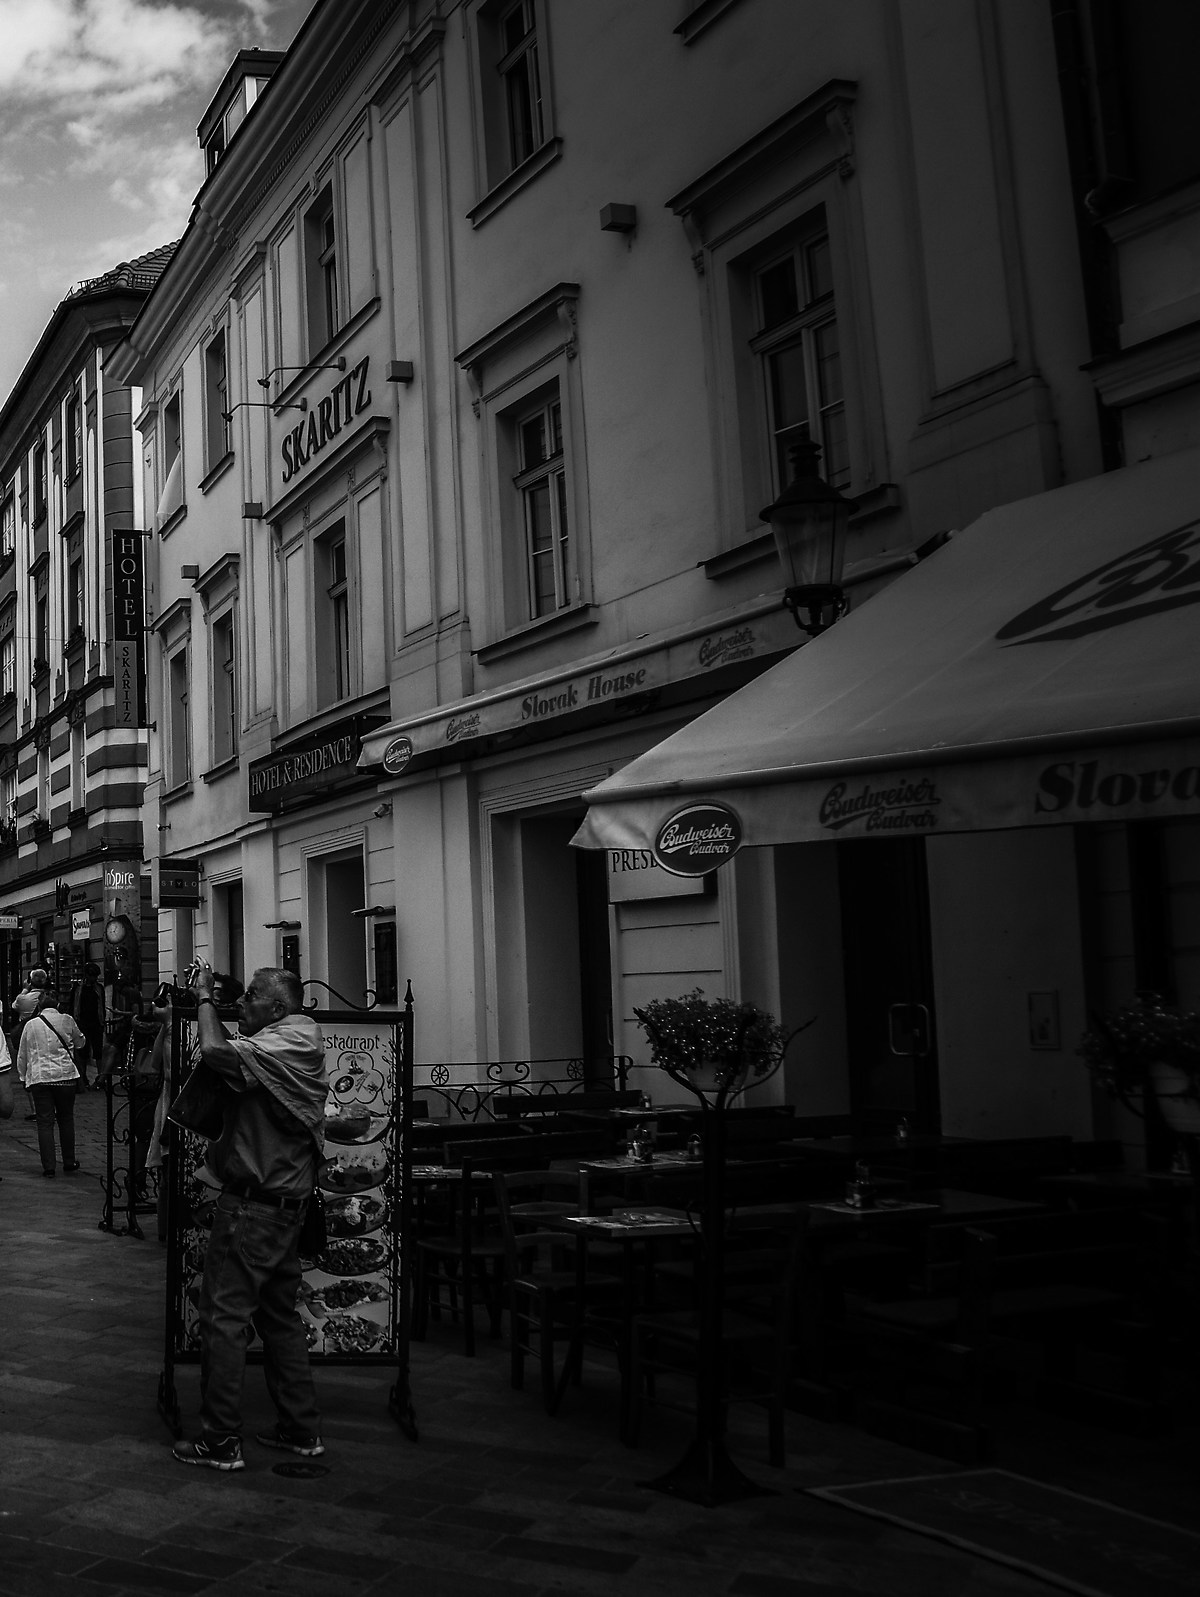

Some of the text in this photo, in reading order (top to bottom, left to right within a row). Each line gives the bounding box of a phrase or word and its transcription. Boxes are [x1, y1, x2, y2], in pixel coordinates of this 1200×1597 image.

[282, 355, 372, 483] SKARITZ
[120, 537, 138, 637] HOTEL
[121, 646, 132, 723] SKARITZ
[521, 668, 647, 720] Slovak House
[250, 735, 352, 797] HOTEL & RESIDENCE
[819, 777, 942, 825] Budweiser
[865, 806, 938, 832] Budvar
[659, 822, 736, 850] Budweiser
[689, 840, 731, 856] Budvar
[160, 879, 198, 888] STYLO
[323, 1034, 380, 1052] staurant
